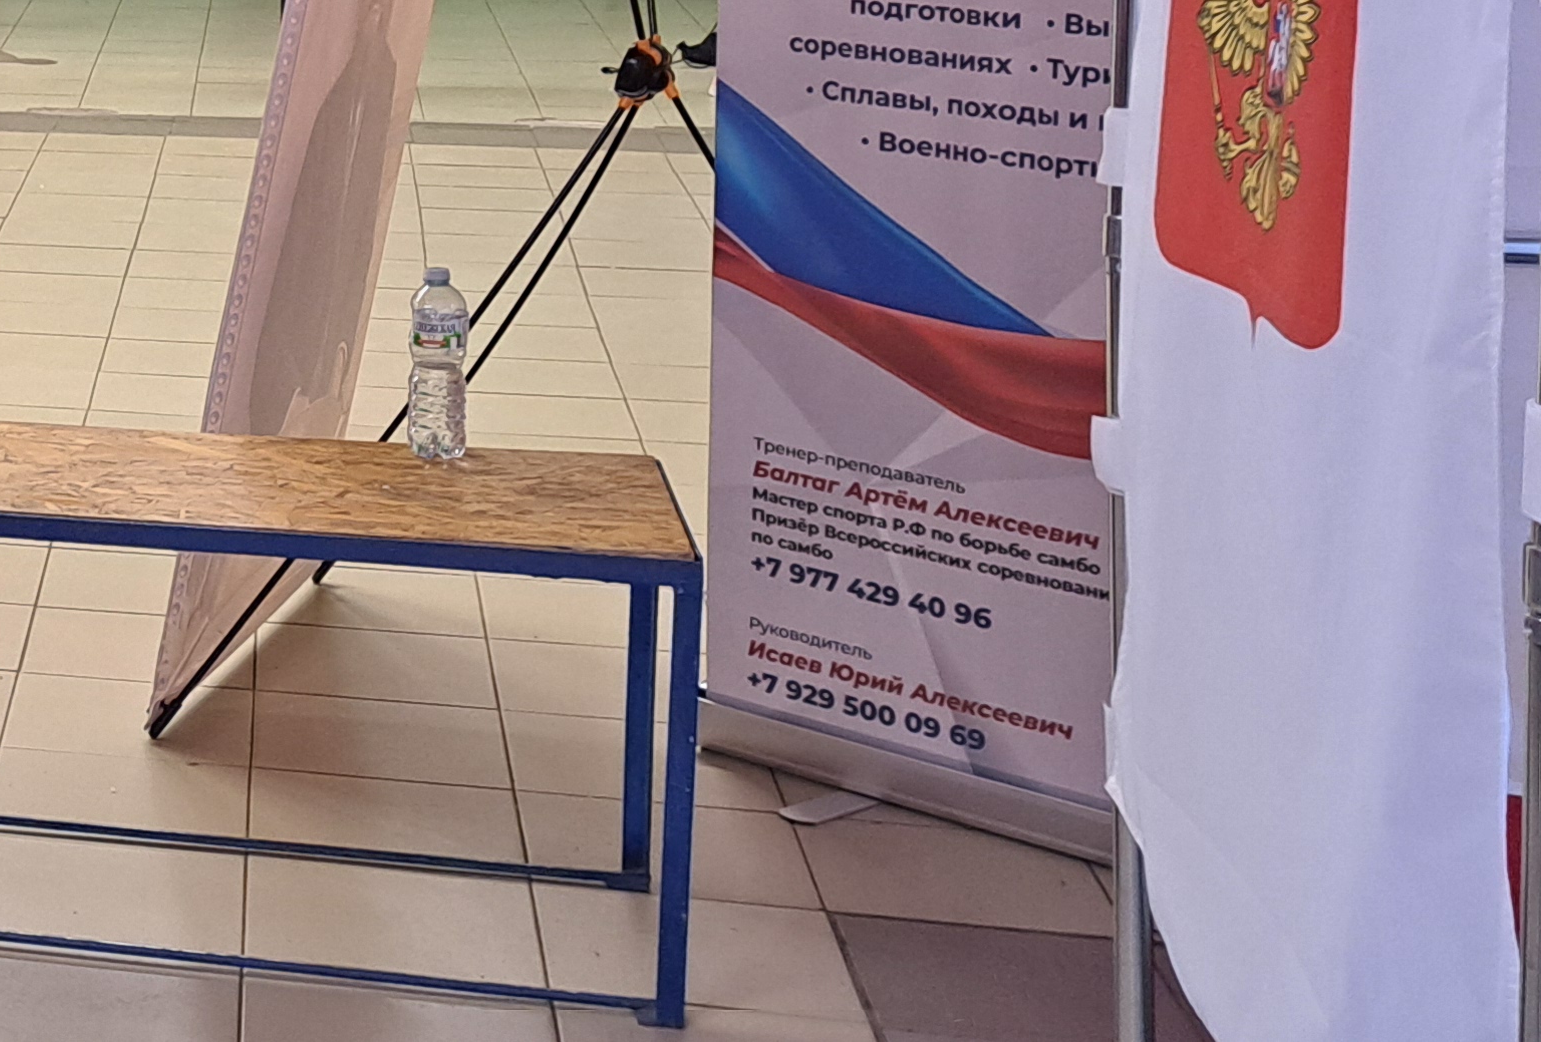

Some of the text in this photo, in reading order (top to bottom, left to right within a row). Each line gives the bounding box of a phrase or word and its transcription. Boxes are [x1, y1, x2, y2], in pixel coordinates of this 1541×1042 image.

[789, 35, 1012, 75] соревнованиях
[822, 80, 939, 114] Сплавы,
[947, 96, 1059, 127] походы
[1069, 112, 1087, 129] и
[753, 436, 966, 494] Тренер-преподаватель
[752, 460, 1100, 550] Балтаг Артём Алексеевич
[752, 486, 818, 515] Мастер
[823, 505, 887, 529] спорта
[931, 528, 954, 544] по
[959, 533, 1031, 560] борьбе
[1037, 552, 1101, 575] самбо
[751, 531, 833, 560] по самбо
[752, 507, 1109, 601] Призёр Всероссийских соревновани
[751, 556, 992, 629] +7 977 429 40 96
[749, 616, 873, 661] Руководитель
[747, 639, 1073, 742] Исаев Юрий Алексеевич
[747, 672, 986, 750] +7 929 500 09 69
